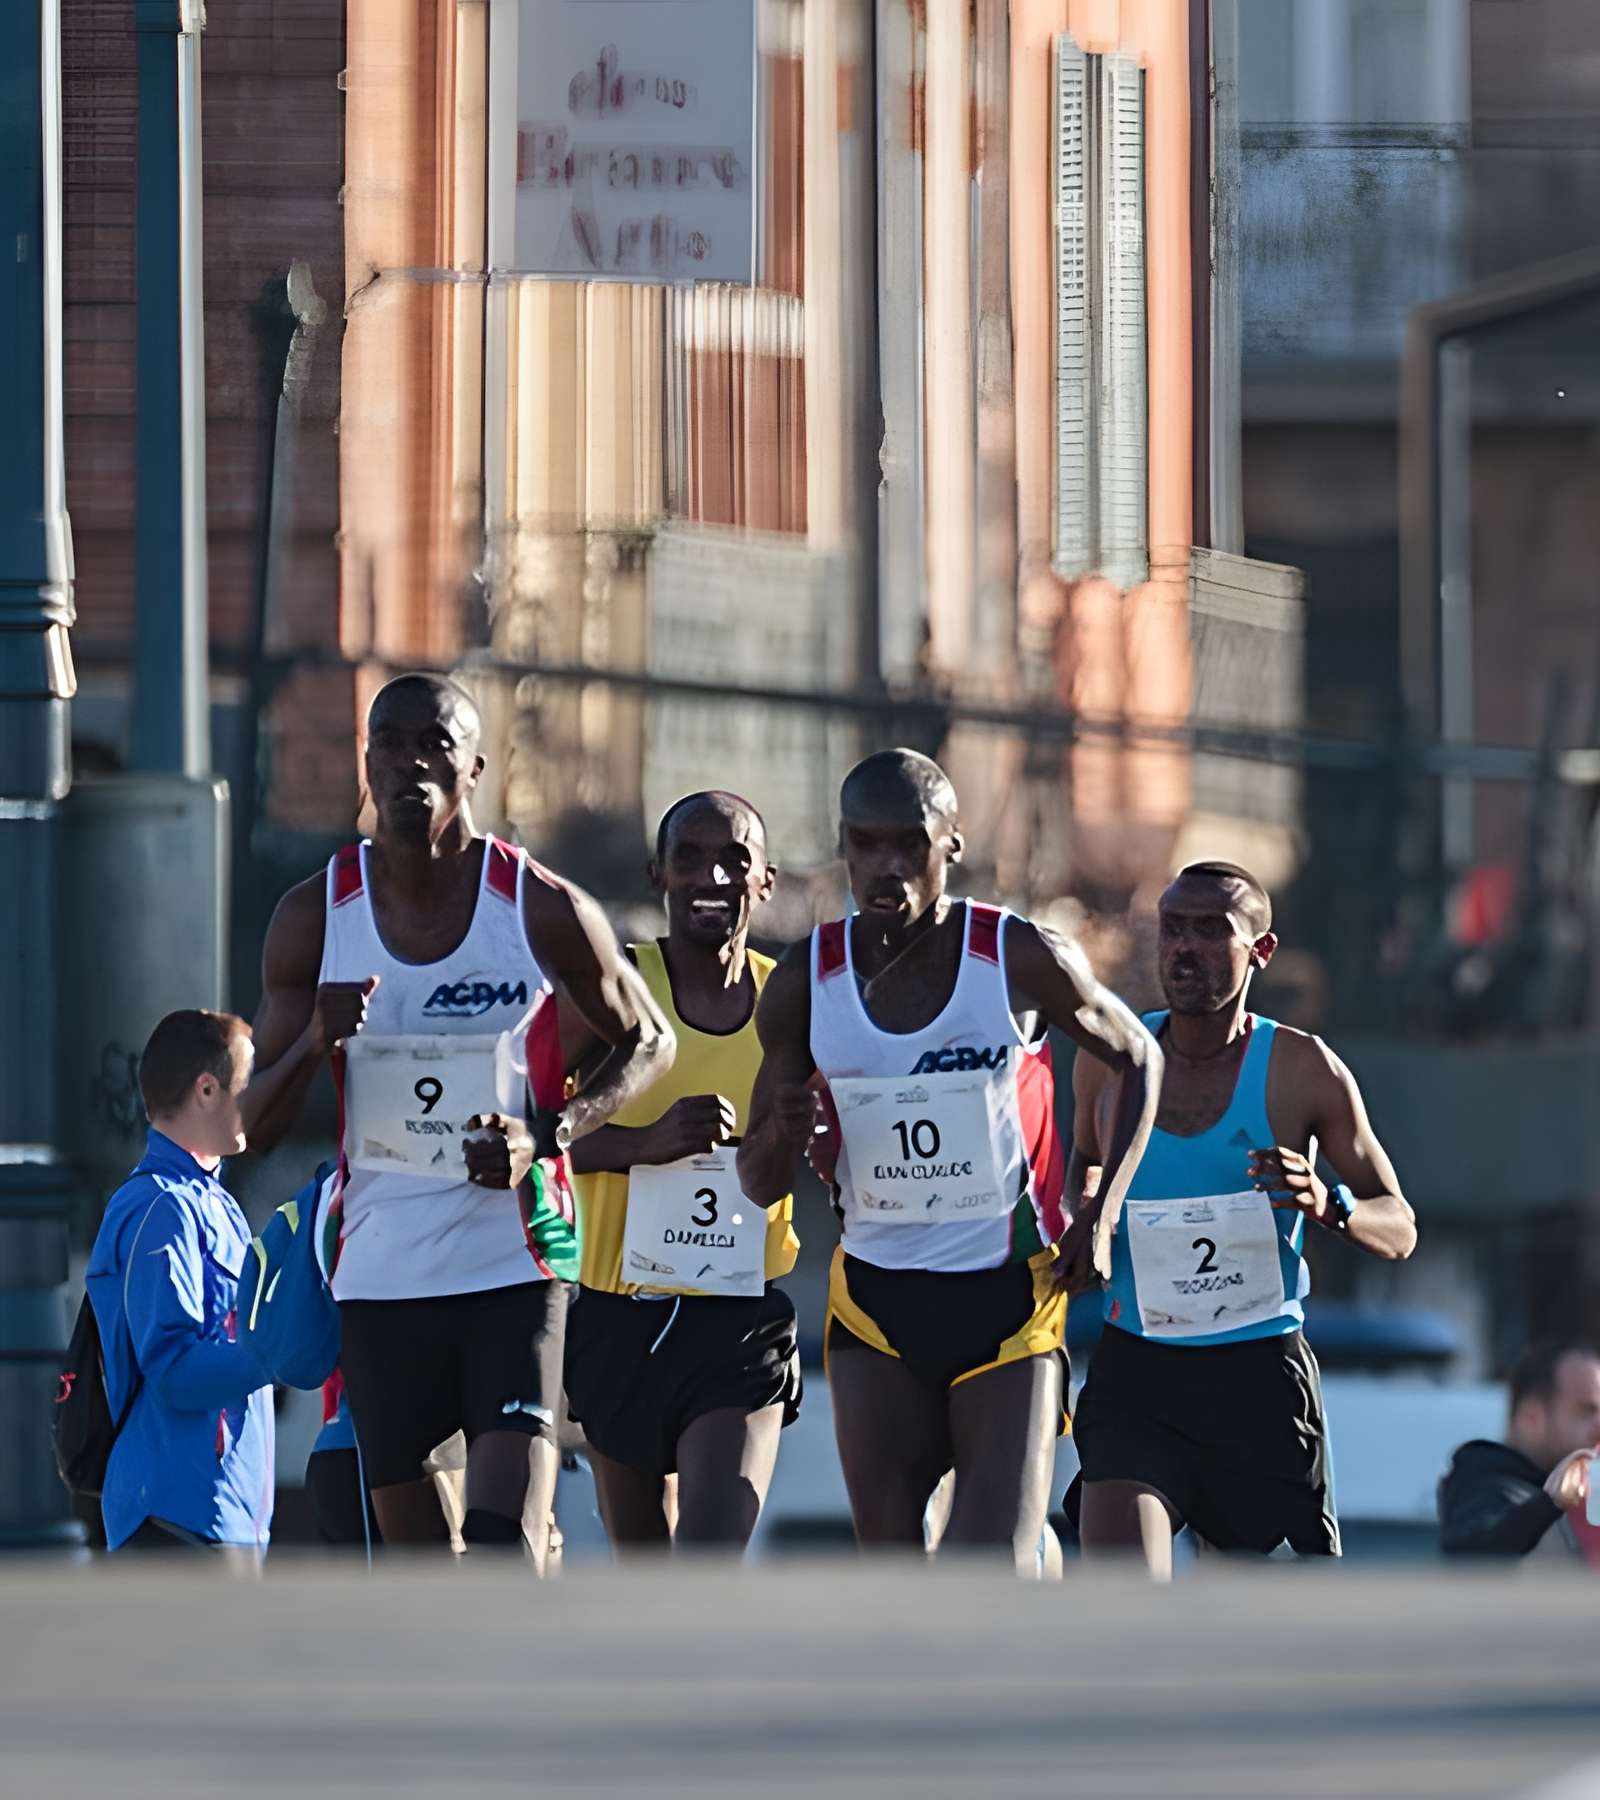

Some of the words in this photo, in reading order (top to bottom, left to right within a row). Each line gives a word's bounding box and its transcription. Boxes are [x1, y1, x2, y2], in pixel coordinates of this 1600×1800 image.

[414, 1077, 443, 1114] 9
[892, 1119, 940, 1160] 10
[691, 1187, 718, 1227] 3
[1192, 1237, 1219, 1275] 2
